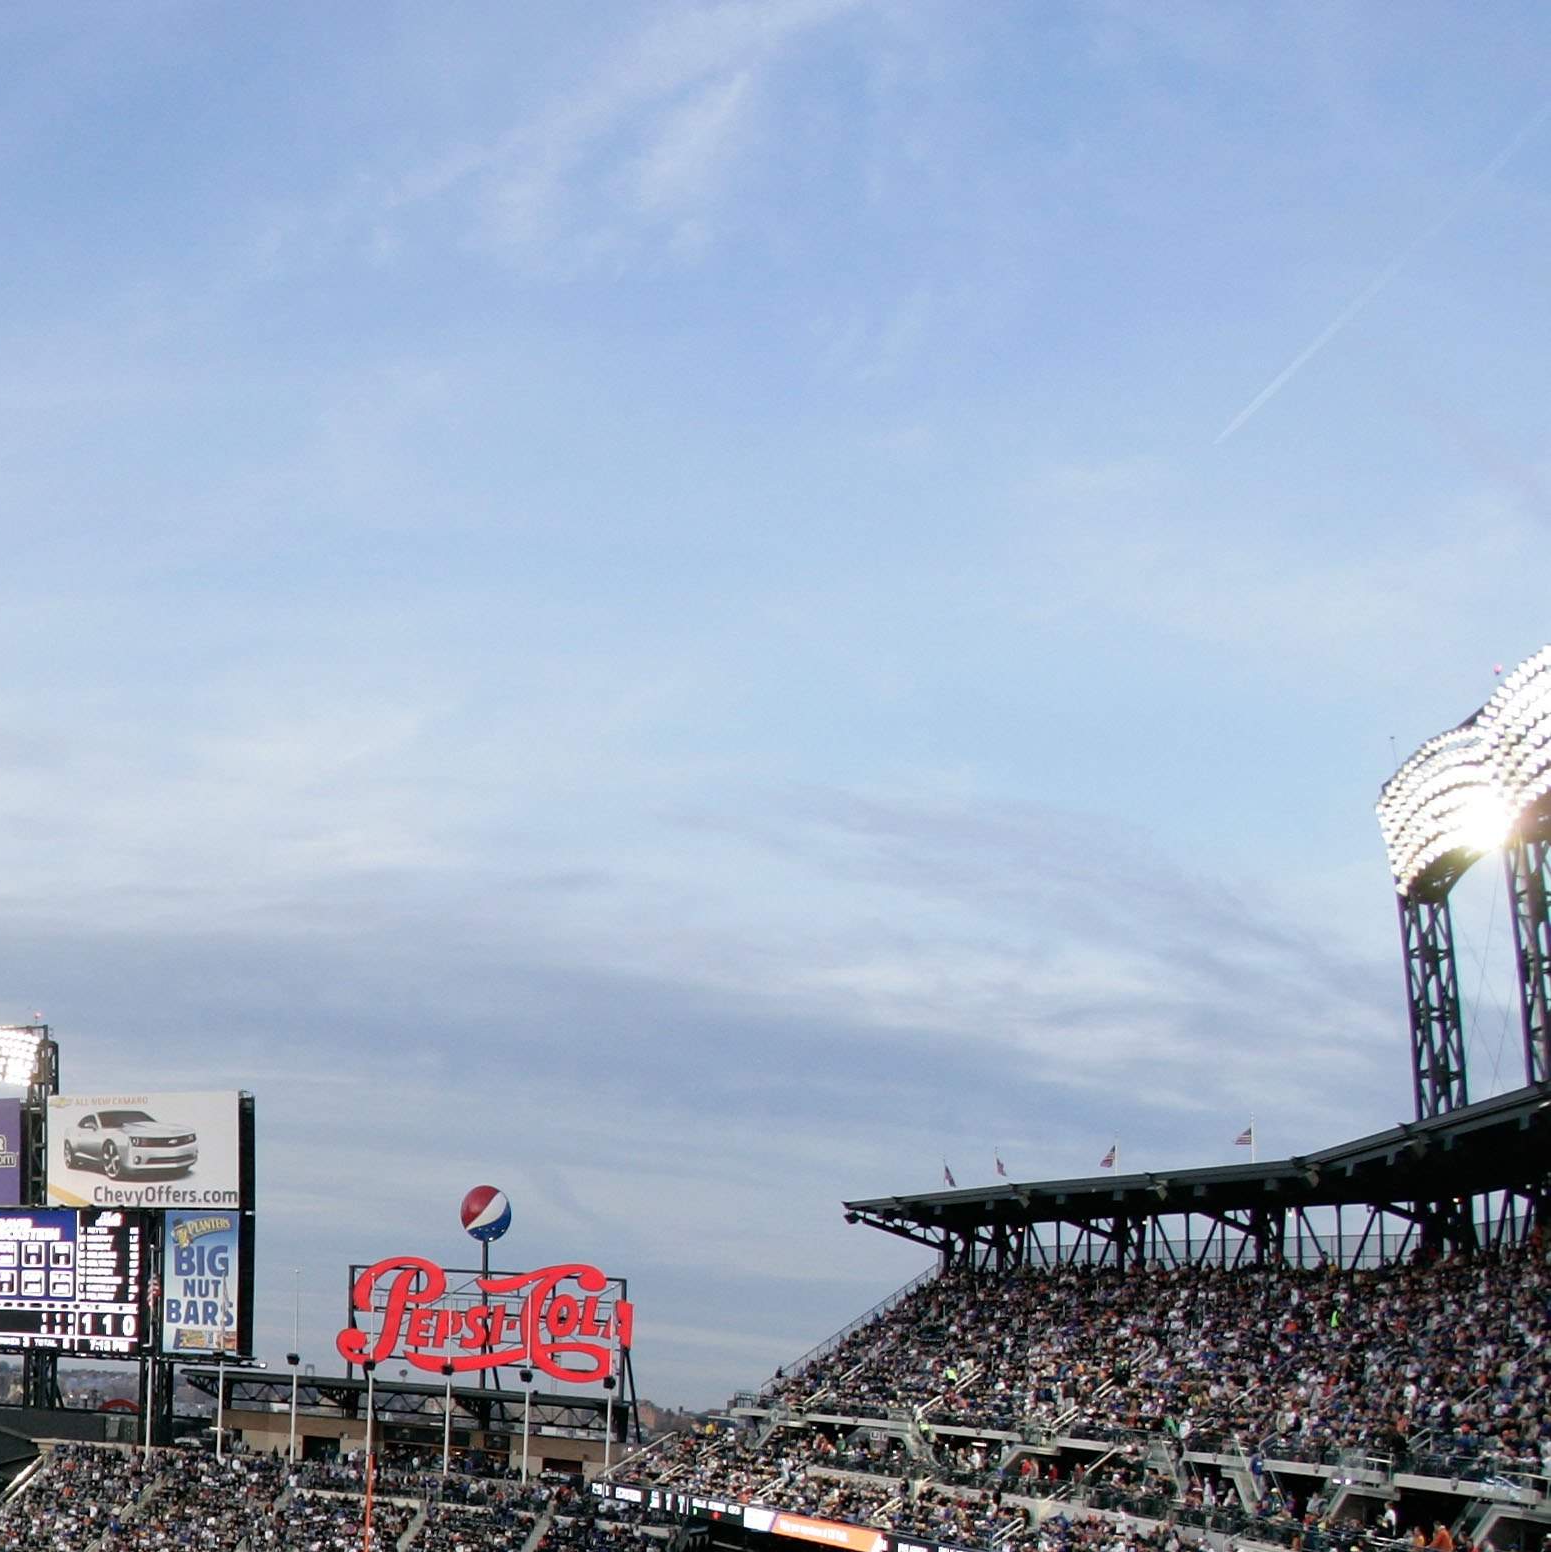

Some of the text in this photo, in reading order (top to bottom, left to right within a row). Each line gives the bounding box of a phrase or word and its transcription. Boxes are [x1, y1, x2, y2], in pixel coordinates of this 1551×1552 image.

[94, 1186, 238, 1206] ChevyOffers.com
[187, 1217, 231, 1236] PLANTERS
[174, 1244, 229, 1277] BIG
[183, 1279, 220, 1297] NUT
[166, 1298, 234, 1326] BARS
[82, 1314, 91, 1334] 1
[103, 1315, 111, 1335] 1
